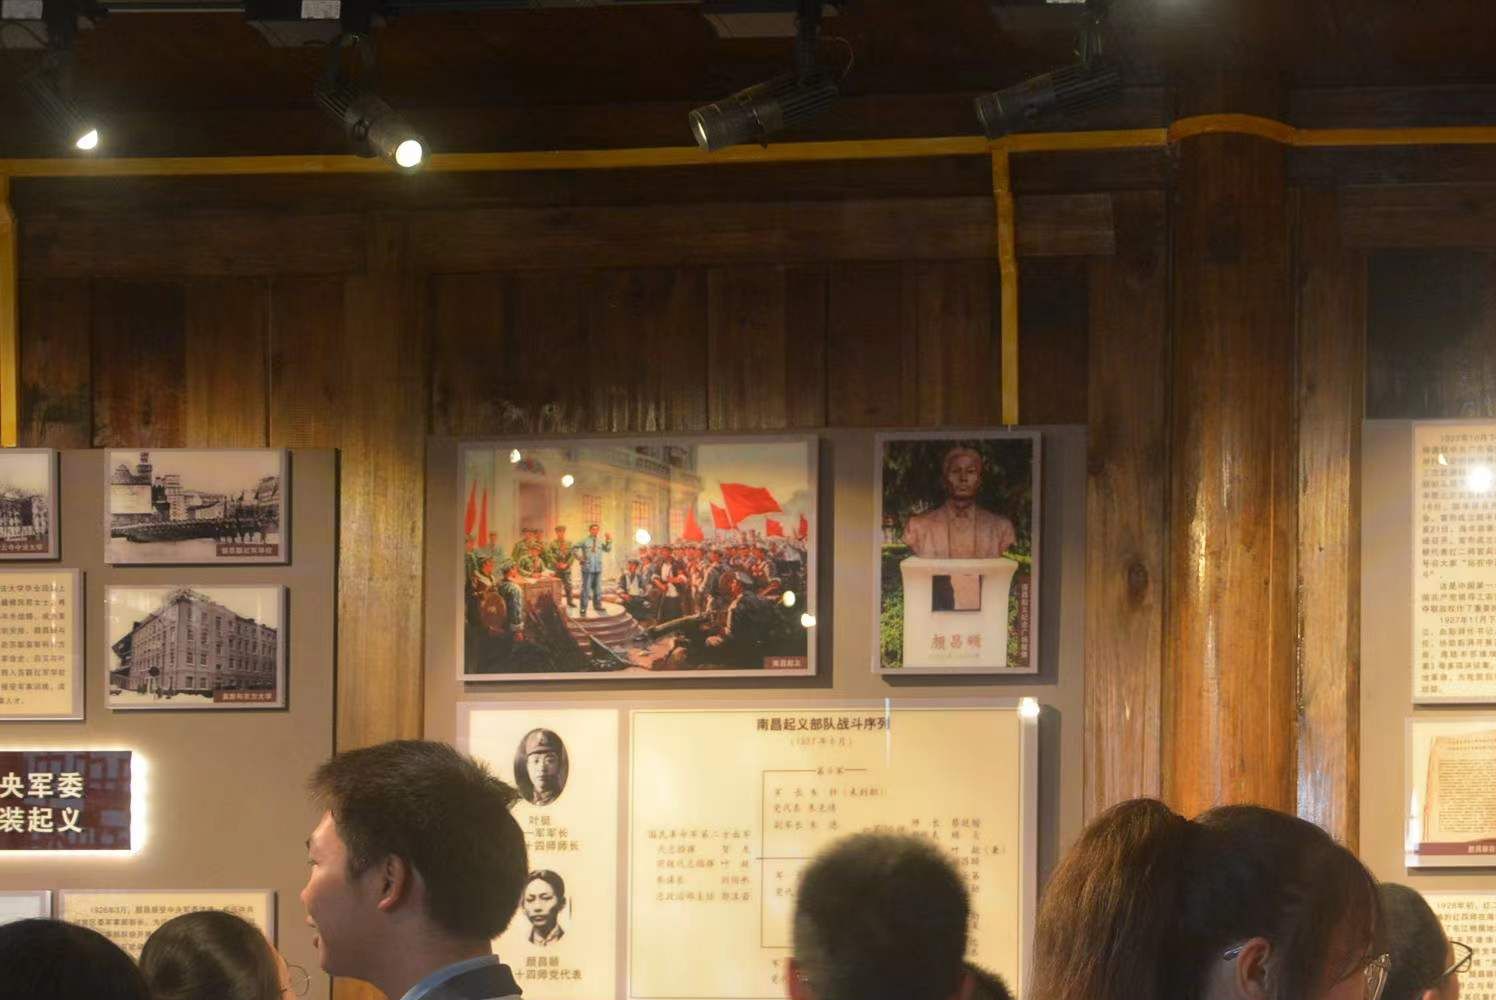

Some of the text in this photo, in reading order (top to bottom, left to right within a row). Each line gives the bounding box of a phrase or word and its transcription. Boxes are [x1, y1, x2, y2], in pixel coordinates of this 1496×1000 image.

[757, 717, 890, 731] 南昌起义部队战斗序列
[0, 772, 83, 798] 央军委
[0, 806, 82, 833] 装起义
